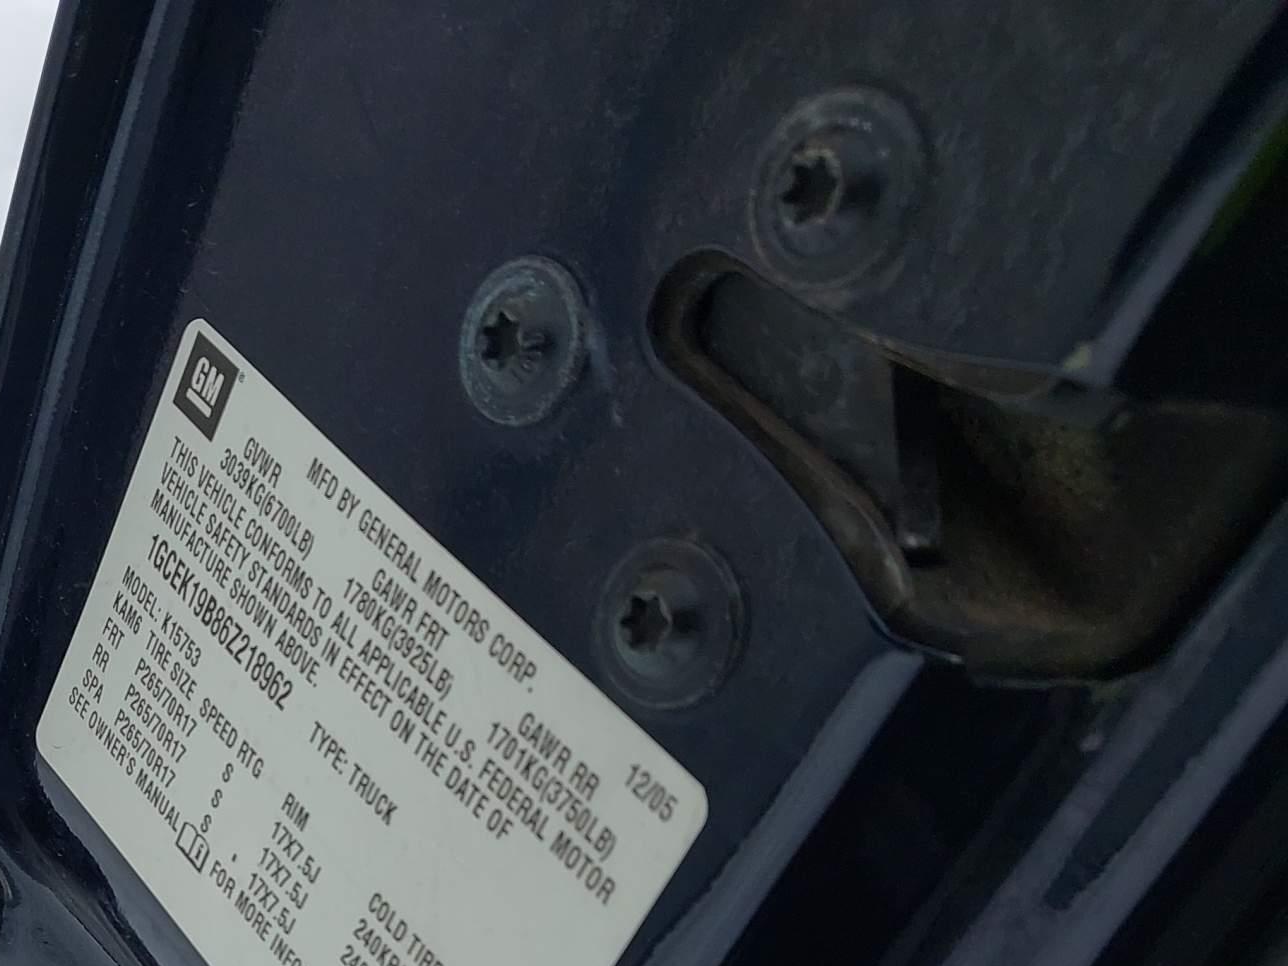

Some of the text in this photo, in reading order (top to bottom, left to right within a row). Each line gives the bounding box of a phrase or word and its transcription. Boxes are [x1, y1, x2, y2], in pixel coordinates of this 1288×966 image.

[191, 357, 225, 406] GM
[242, 436, 283, 489] GVWR
[219, 447, 315, 562] 3039KG(6700LB)
[112, 590, 143, 636] KAM6
[149, 487, 321, 688] MANUFACTURE SHOWN ABOVE.
[306, 456, 537, 693] MFD BY GENERAL MOTORS CORP.
[371, 567, 451, 652] GAWR FRT
[101, 616, 126, 651] FRT
[121, 564, 202, 668] MODEL: K15753
[147, 533, 294, 712] 1GCEK19B86Z218962
[160, 460, 514, 839] VEHICLE SAFETY STANDARDS IN EFFECT ON THE DATE OF
[343, 577, 454, 702] 1780KG(3925LB)
[82, 668, 104, 705] SPA
[91, 641, 110, 674] RR
[133, 657, 198, 738] P265/70R17
[145, 628, 198, 702] TIRE SIZE
[169, 435, 616, 905] THIS VEHICLE CONFORMS TO ALL APPLICABLE U.S. FEDERAL MOTOR
[113, 707, 177, 789] P265/70R17
[123, 682, 187, 764] P265/70R17
[198, 697, 265, 780] SPEED RTG
[517, 712, 600, 801] GAWR RR
[68, 685, 91, 721] SEE
[88, 709, 137, 777] OWNER'S
[134, 767, 181, 833] MANUAL
[208, 859, 236, 900] FOR
[234, 889, 273, 942] MORE
[210, 788, 224, 809] S
[221, 762, 235, 784] S
[280, 791, 310, 833] RIM
[309, 720, 398, 826] TYPE: TRUCK
[487, 722, 616, 862] 1701KG(3750LB)
[625, 764, 678, 822] 12/05
[199, 813, 213, 835] S
[271, 821, 322, 885] 17X7.5J
[247, 872, 297, 935] 17X7.5J
[258, 847, 309, 910] 17X7.5J
[368, 892, 408, 943] COLD
